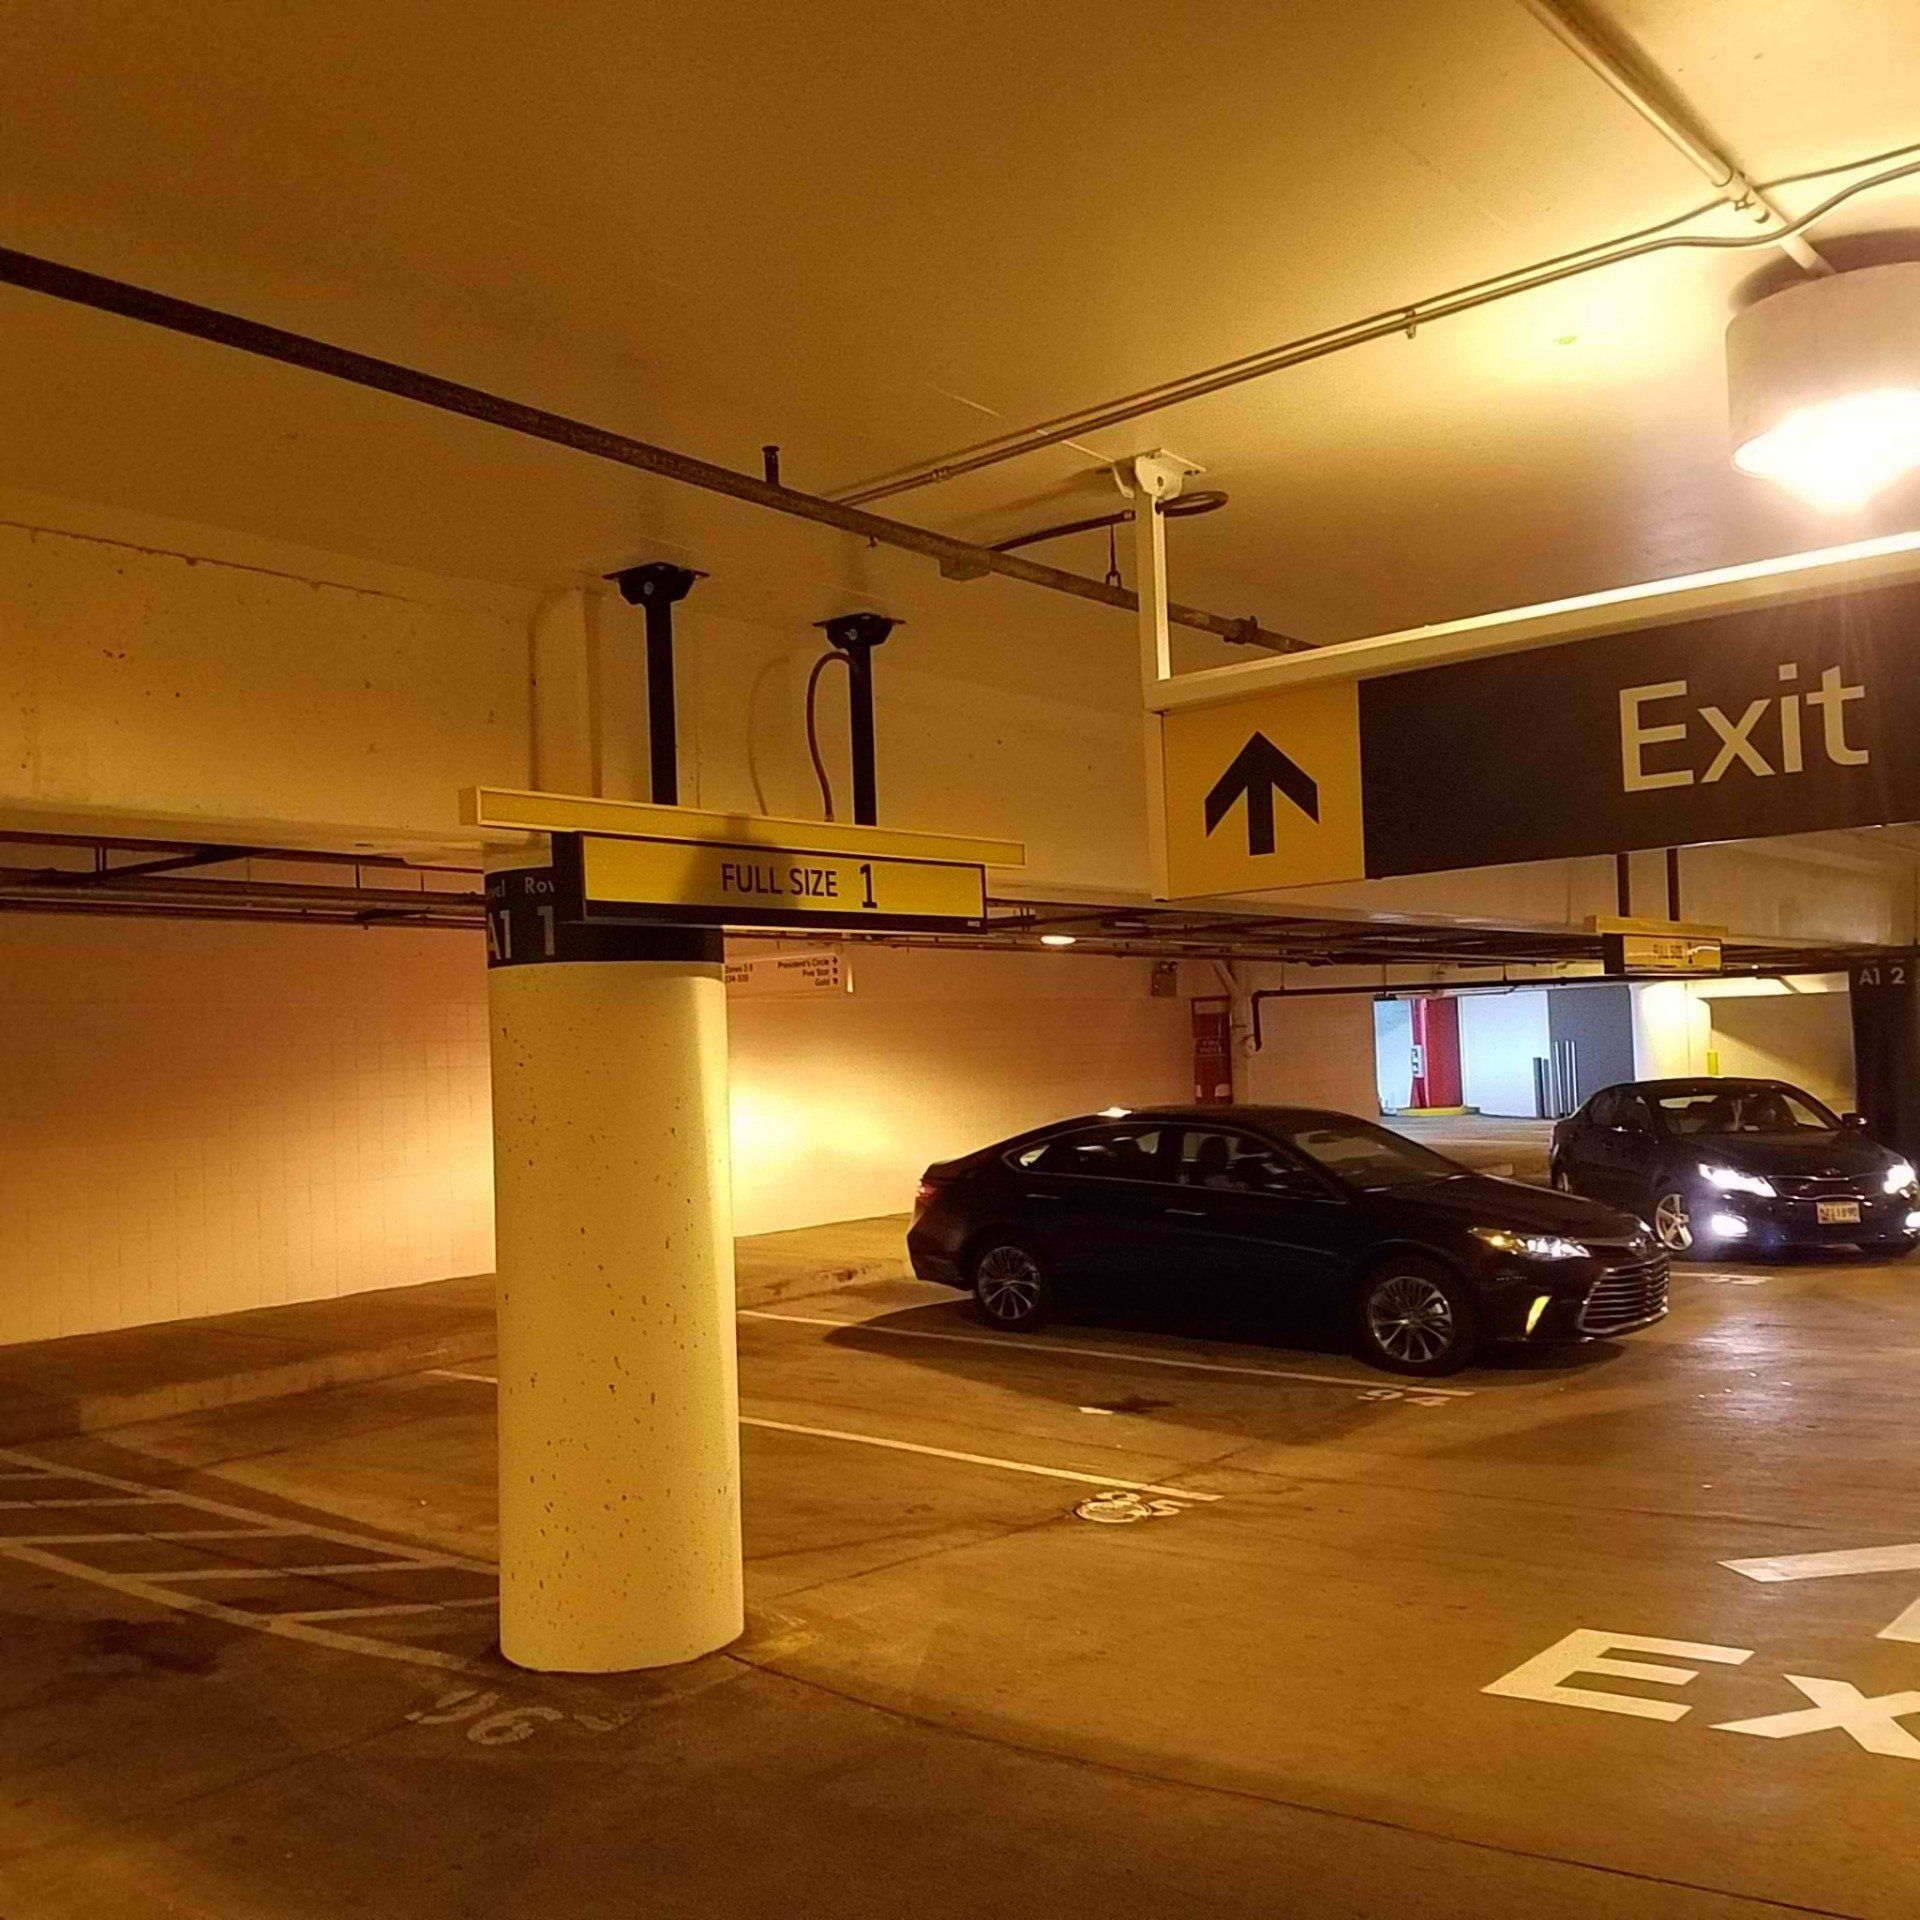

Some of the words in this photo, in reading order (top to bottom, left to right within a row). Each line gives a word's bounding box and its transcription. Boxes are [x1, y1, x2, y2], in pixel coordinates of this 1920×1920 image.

[1619, 664, 1869, 792] Exit
[721, 863, 783, 894] FULL
[789, 868, 838, 897] SIZE
[859, 863, 878, 909] 1
[537, 905, 555, 956] 1
[1859, 968, 1880, 985] A1
[1890, 967, 1906, 985] 2
